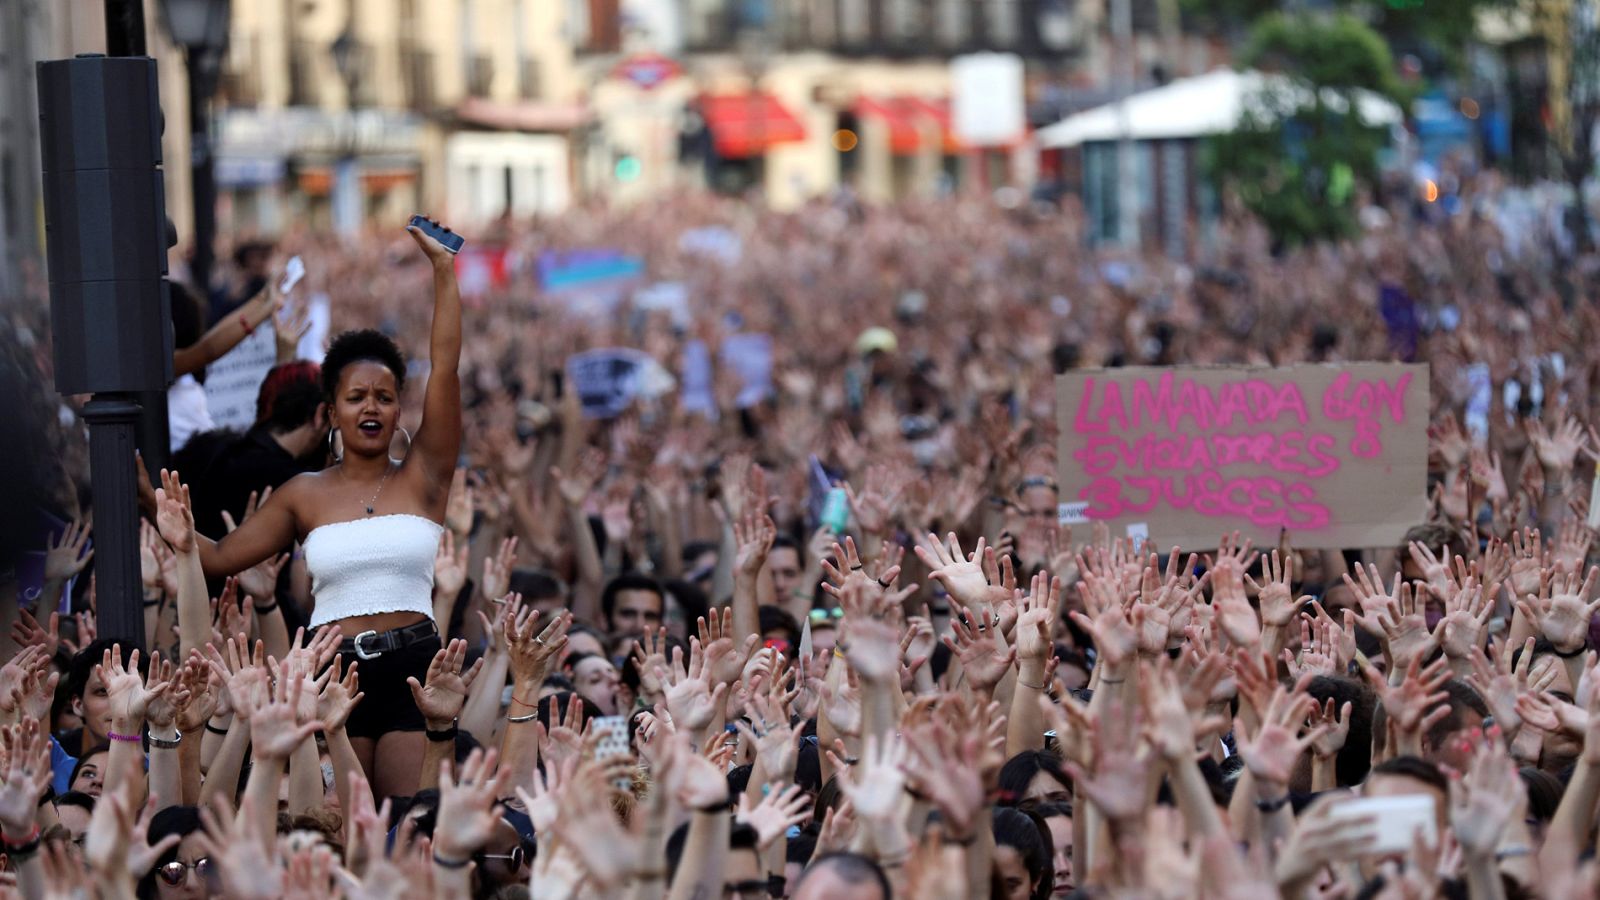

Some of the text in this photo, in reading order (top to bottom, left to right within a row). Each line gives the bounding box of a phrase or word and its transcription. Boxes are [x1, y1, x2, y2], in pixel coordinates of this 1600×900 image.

[1073, 376, 1130, 434] LA
[1131, 371, 1310, 433] MANADA
[1119, 431, 1341, 478] VIOLADORES
[1123, 470, 1332, 532] JUECES
